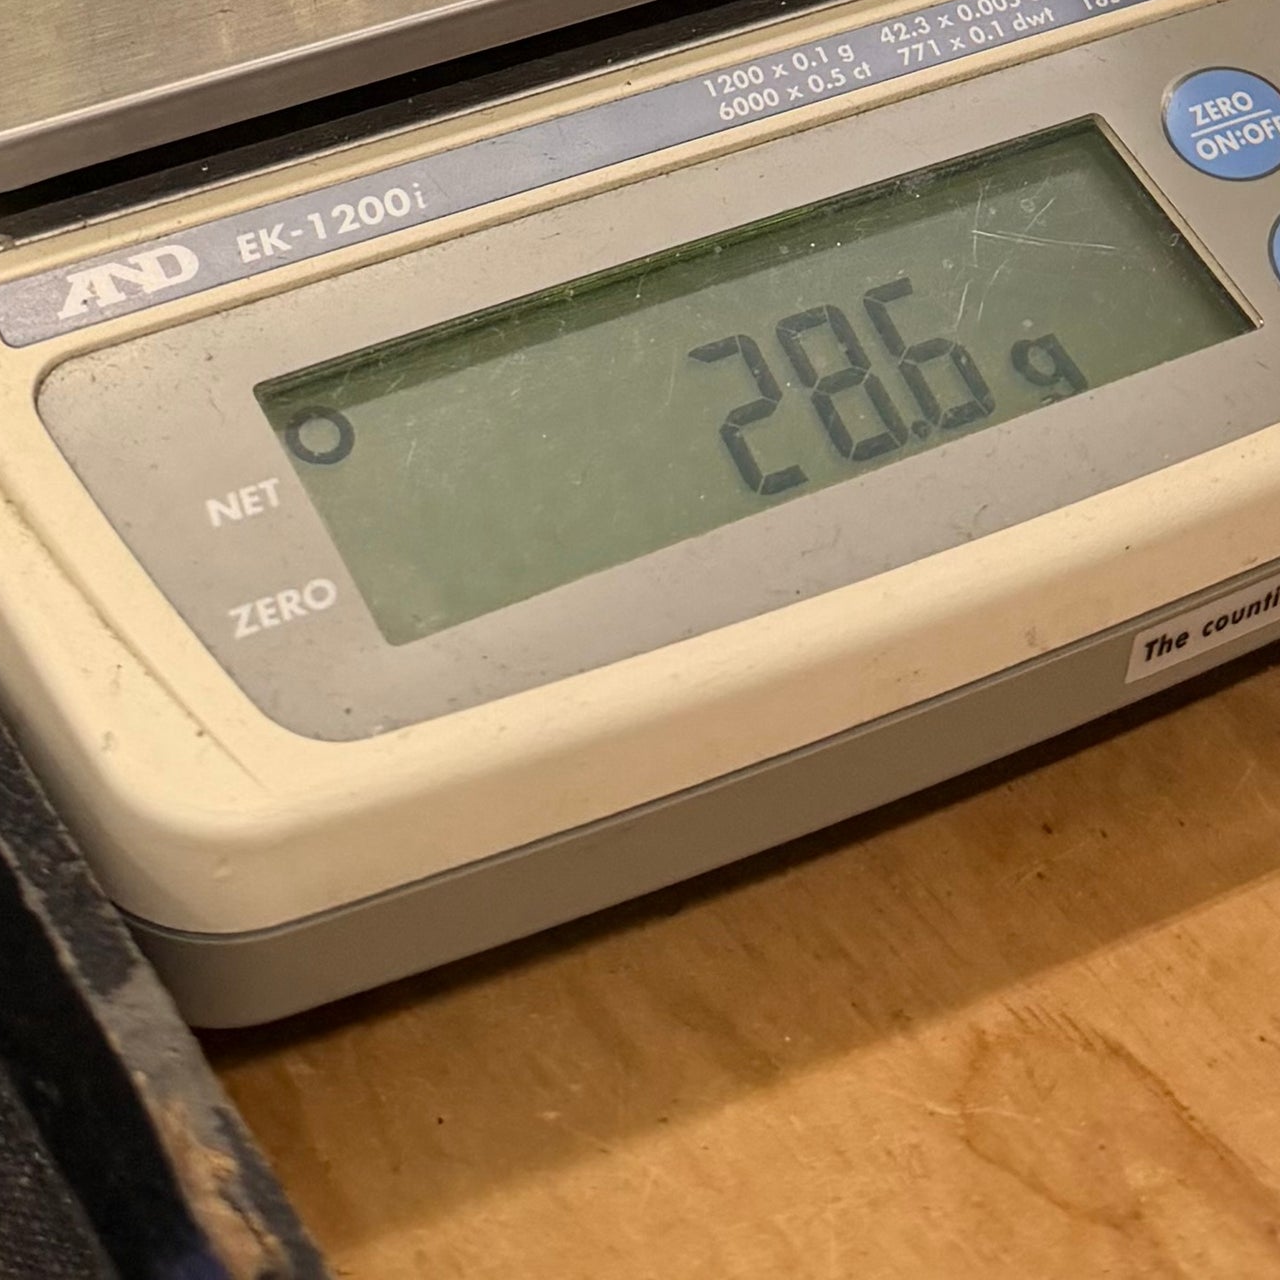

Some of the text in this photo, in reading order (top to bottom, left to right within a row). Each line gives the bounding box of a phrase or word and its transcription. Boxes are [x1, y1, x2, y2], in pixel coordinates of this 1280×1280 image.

[703, 65, 764, 98] 1200
[772, 63, 789, 79] x
[792, 45, 829, 72] 0.1
[837, 44, 855, 63] g
[879, 17, 932, 45] 42.3
[937, 13, 954, 30] x
[719, 89, 780, 122] 6000
[788, 85, 804, 102] x
[808, 68, 846, 94] 0.5
[853, 61, 872, 80] ct
[896, 38, 941, 67] 771
[950, 35, 966, 51] x
[969, 21, 1004, 45] 0.1
[1012, 6, 1055, 33] dwt
[1189, 90, 1254, 127] ZERO
[236, 182, 426, 264] EK-1200i
[688, 277, 1088, 496] 28.6 g
[204, 477, 280, 528] NET
[228, 578, 337, 640] ZERO
[1142, 627, 1190, 662] The
